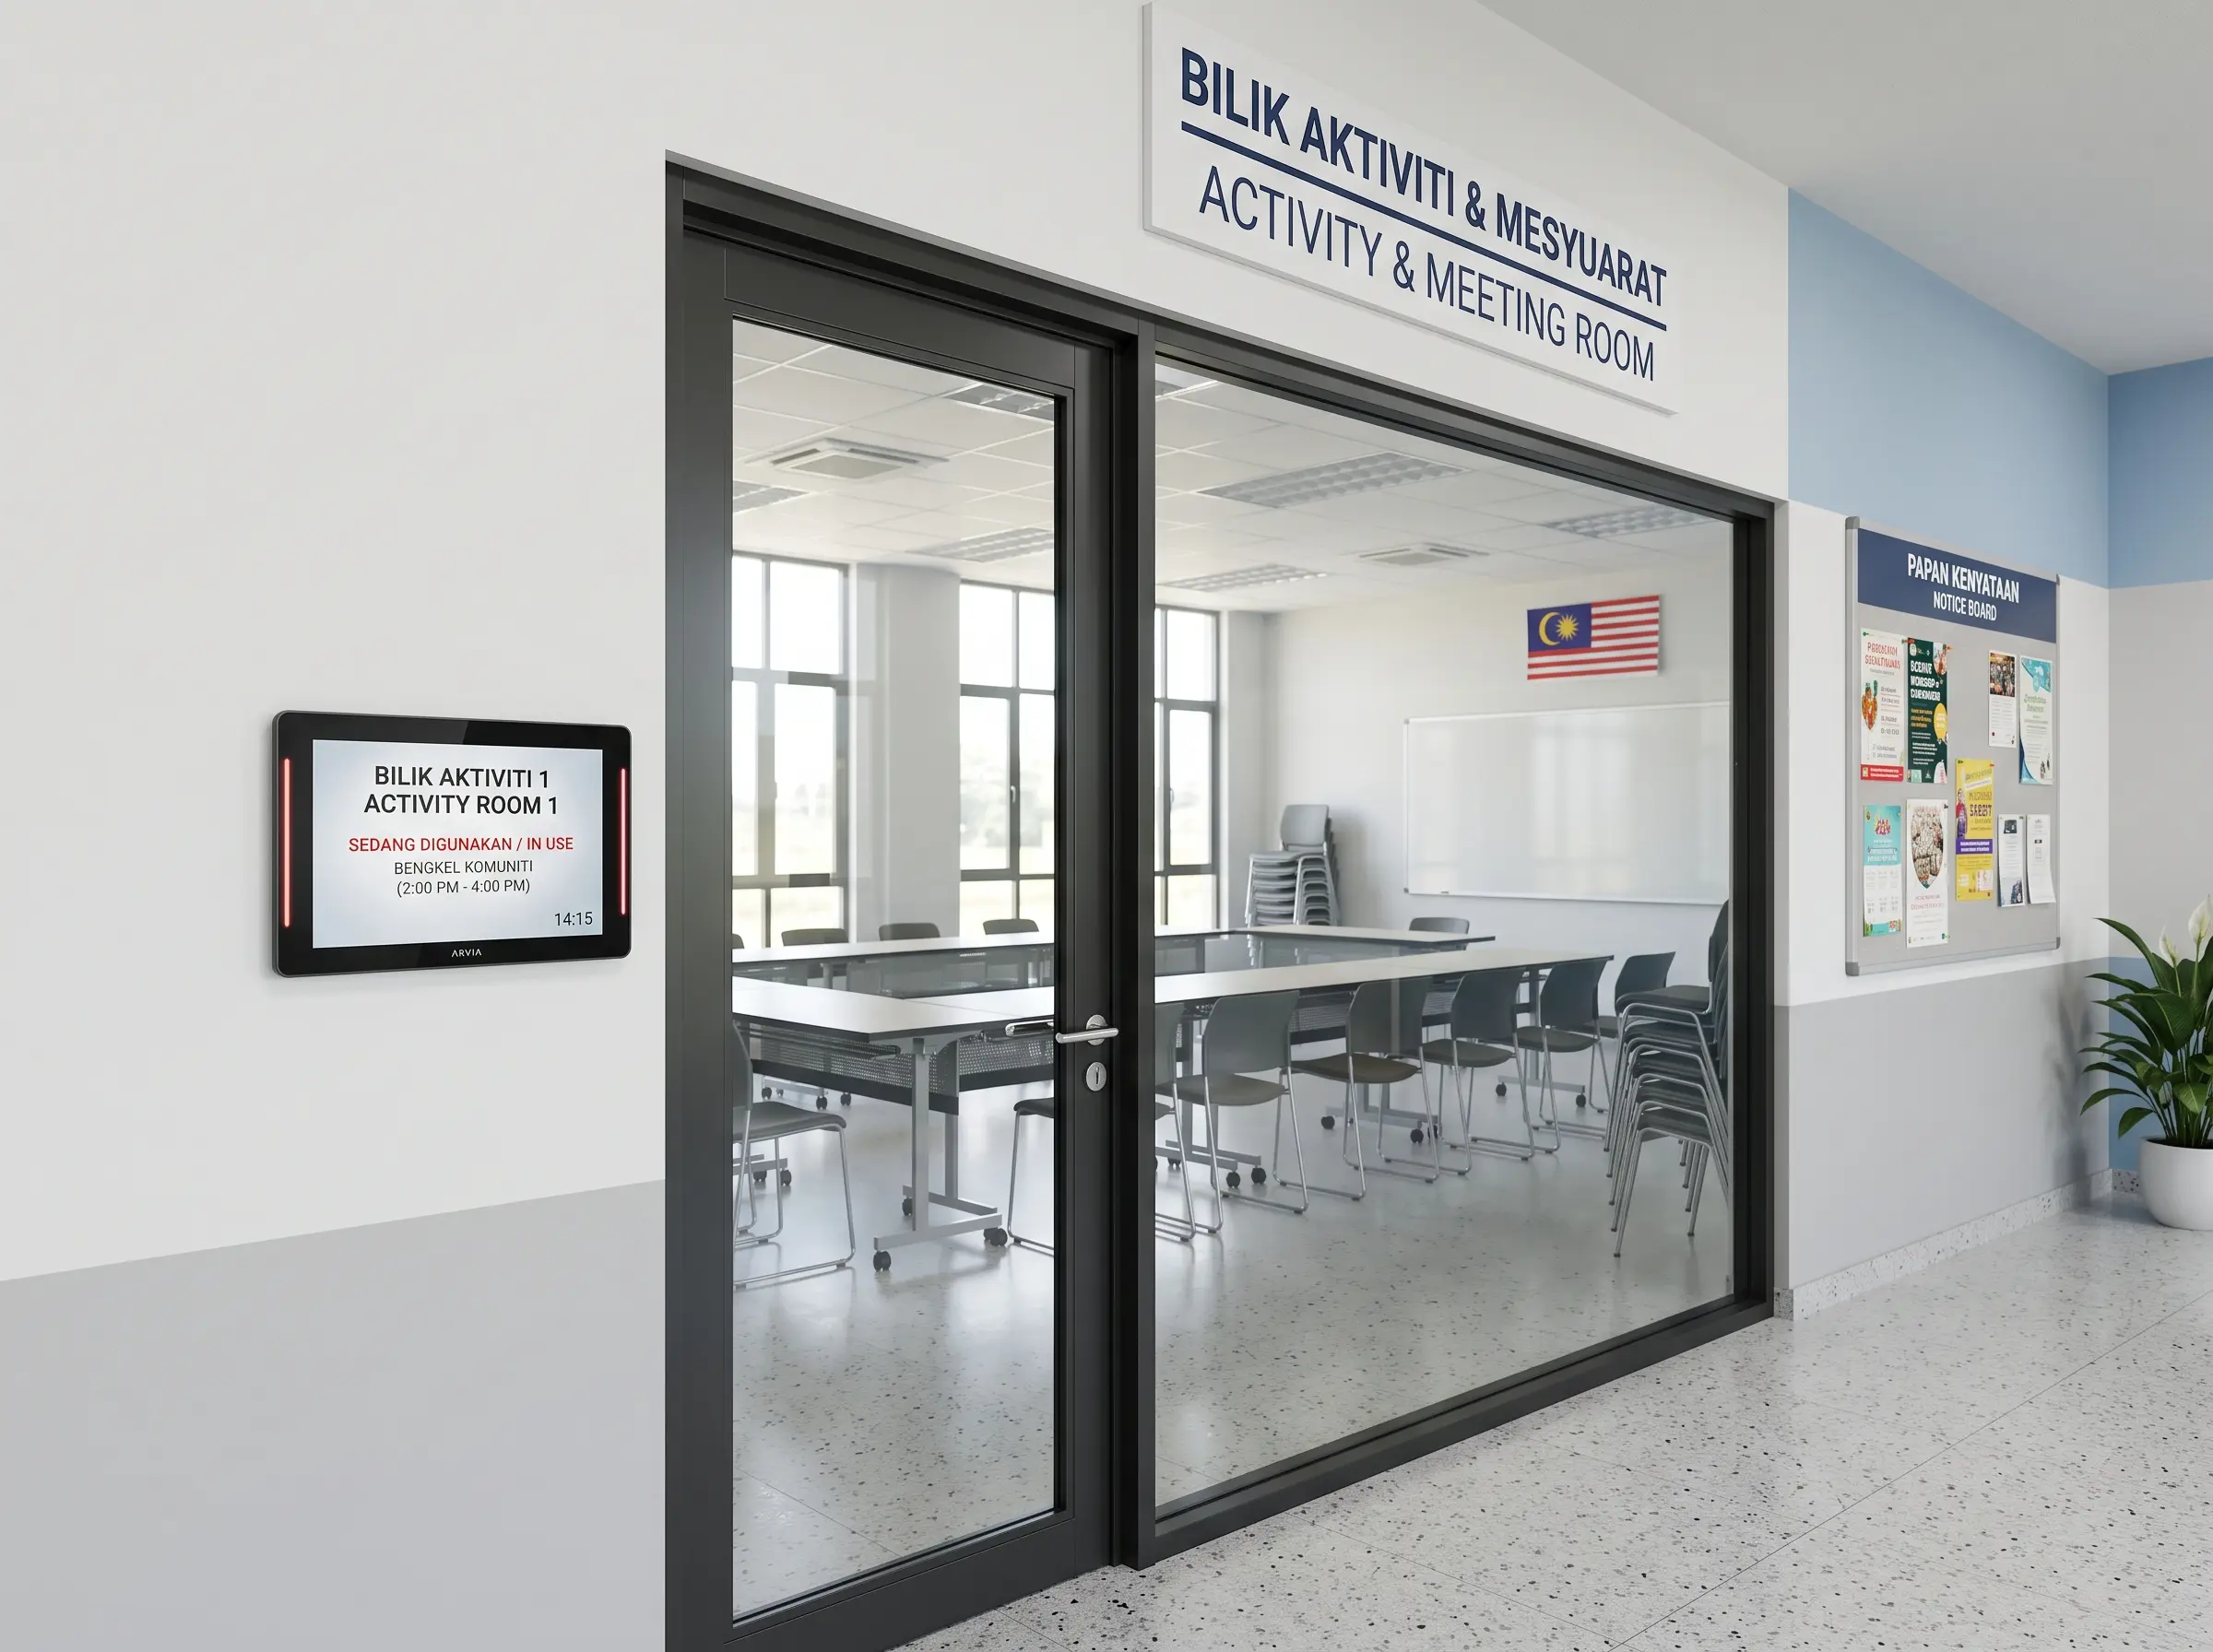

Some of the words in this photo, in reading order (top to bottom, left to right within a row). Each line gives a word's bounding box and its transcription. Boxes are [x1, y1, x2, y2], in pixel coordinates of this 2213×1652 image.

[1181, 46, 1291, 147] BILIK
[1299, 106, 1454, 218] AKTIVITI
[1464, 180, 1486, 231] &
[1497, 192, 1667, 307] MESYUARAT
[1199, 165, 1383, 277] ACTIVITY
[1392, 240, 1415, 293] &
[1426, 252, 1565, 347] MEETING
[1576, 312, 1654, 382] ROOM
[1907, 552, 1949, 586] PAPAN
[1951, 564, 2019, 604] KENYATAAN
[1933, 590, 1967, 615] NOTICE
[1968, 598, 1997, 621] BOARD
[374, 765, 433, 786] BILIK
[438, 767, 532, 788] AKTIVITI
[538, 770, 549, 789] 1
[363, 793, 470, 814] ACTIVITY
[477, 795, 542, 815] ROOM
[548, 796, 557, 815] 1
[349, 837, 415, 852] SEDANG
[420, 837, 512, 852] DIGUNAKAN
[515, 837, 523, 852] /
[527, 837, 541, 851] IN
[546, 836, 574, 851] USE
[394, 861, 461, 875] BENGKEL
[465, 859, 533, 874] KOMUNITI
[396, 880, 432, 899] (2:00
[437, 880, 459, 894] PM
[471, 879, 500, 893] 4:00
[503, 878, 530, 896] PM)
[553, 911, 594, 926] 14:15
[451, 948, 482, 958] ARVIA
